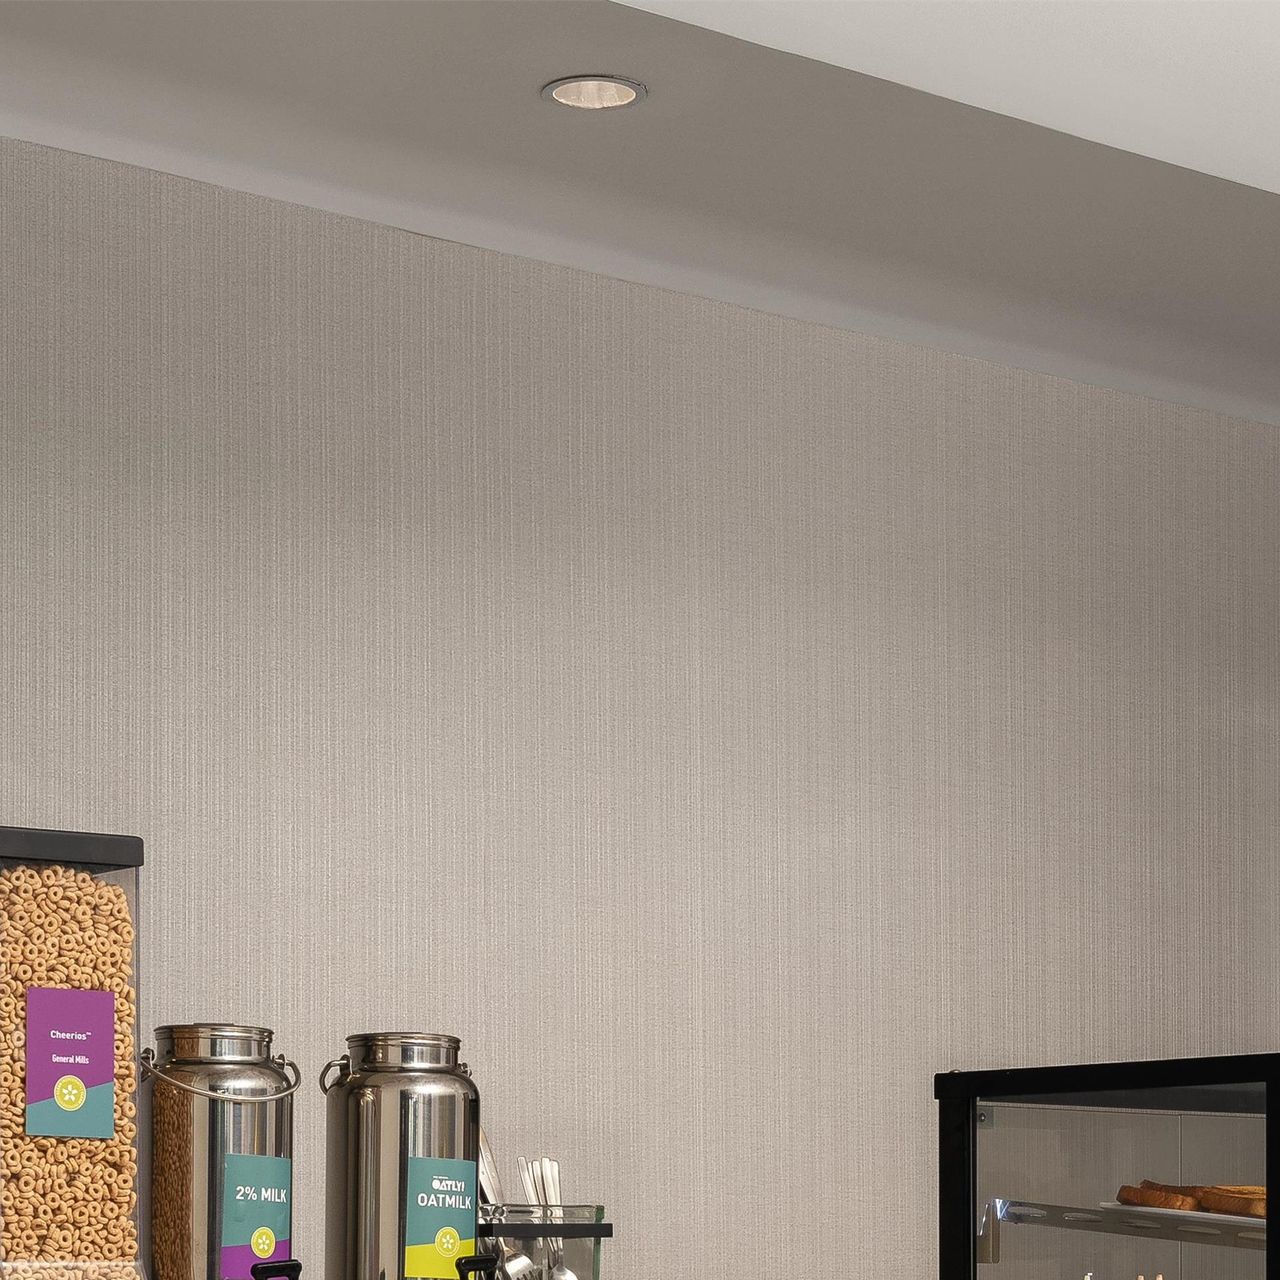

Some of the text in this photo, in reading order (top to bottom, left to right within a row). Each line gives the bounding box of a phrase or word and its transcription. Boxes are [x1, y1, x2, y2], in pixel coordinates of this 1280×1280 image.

[52, 1054, 89, 1064] General Mills
[432, 1179, 465, 1192] OATLY!
[235, 1186, 287, 1203] 2% MILK
[417, 1193, 471, 1209] OATMILK
